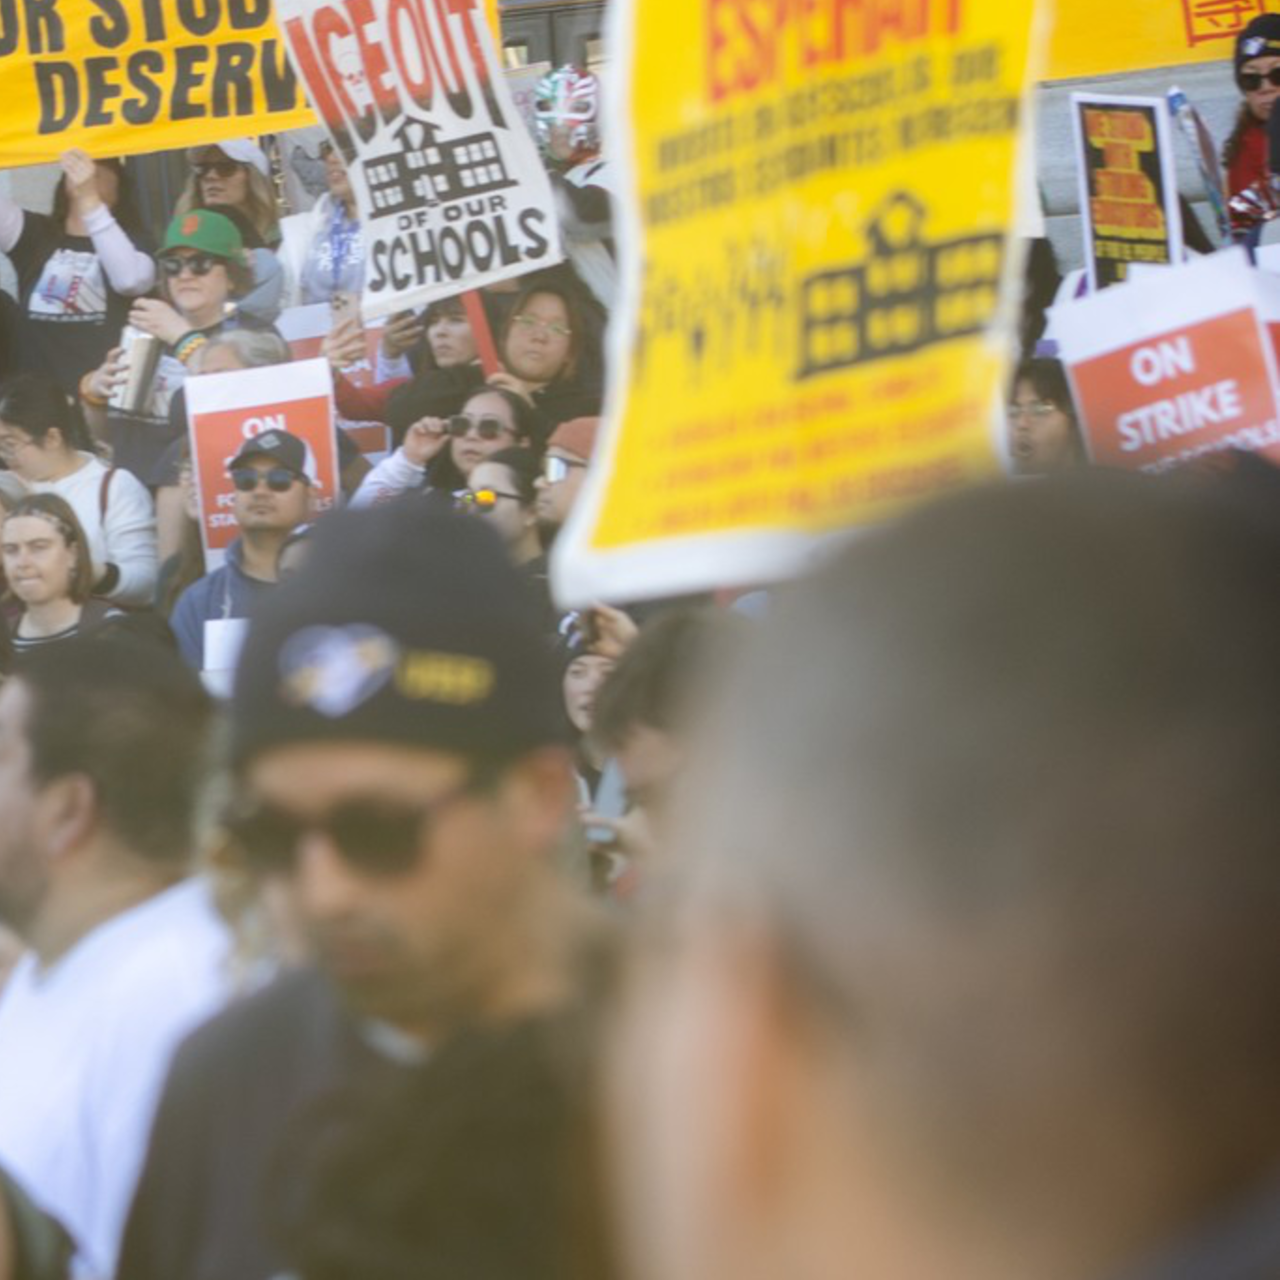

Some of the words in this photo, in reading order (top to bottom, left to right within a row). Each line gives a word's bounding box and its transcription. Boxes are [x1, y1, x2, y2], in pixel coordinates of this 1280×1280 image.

[398, 213, 427, 230] OF
[445, 195, 508, 221] OUR
[368, 207, 549, 293] SCHOOLS
[1131, 337, 1194, 386] ON
[1117, 379, 1242, 452] STRIKE
